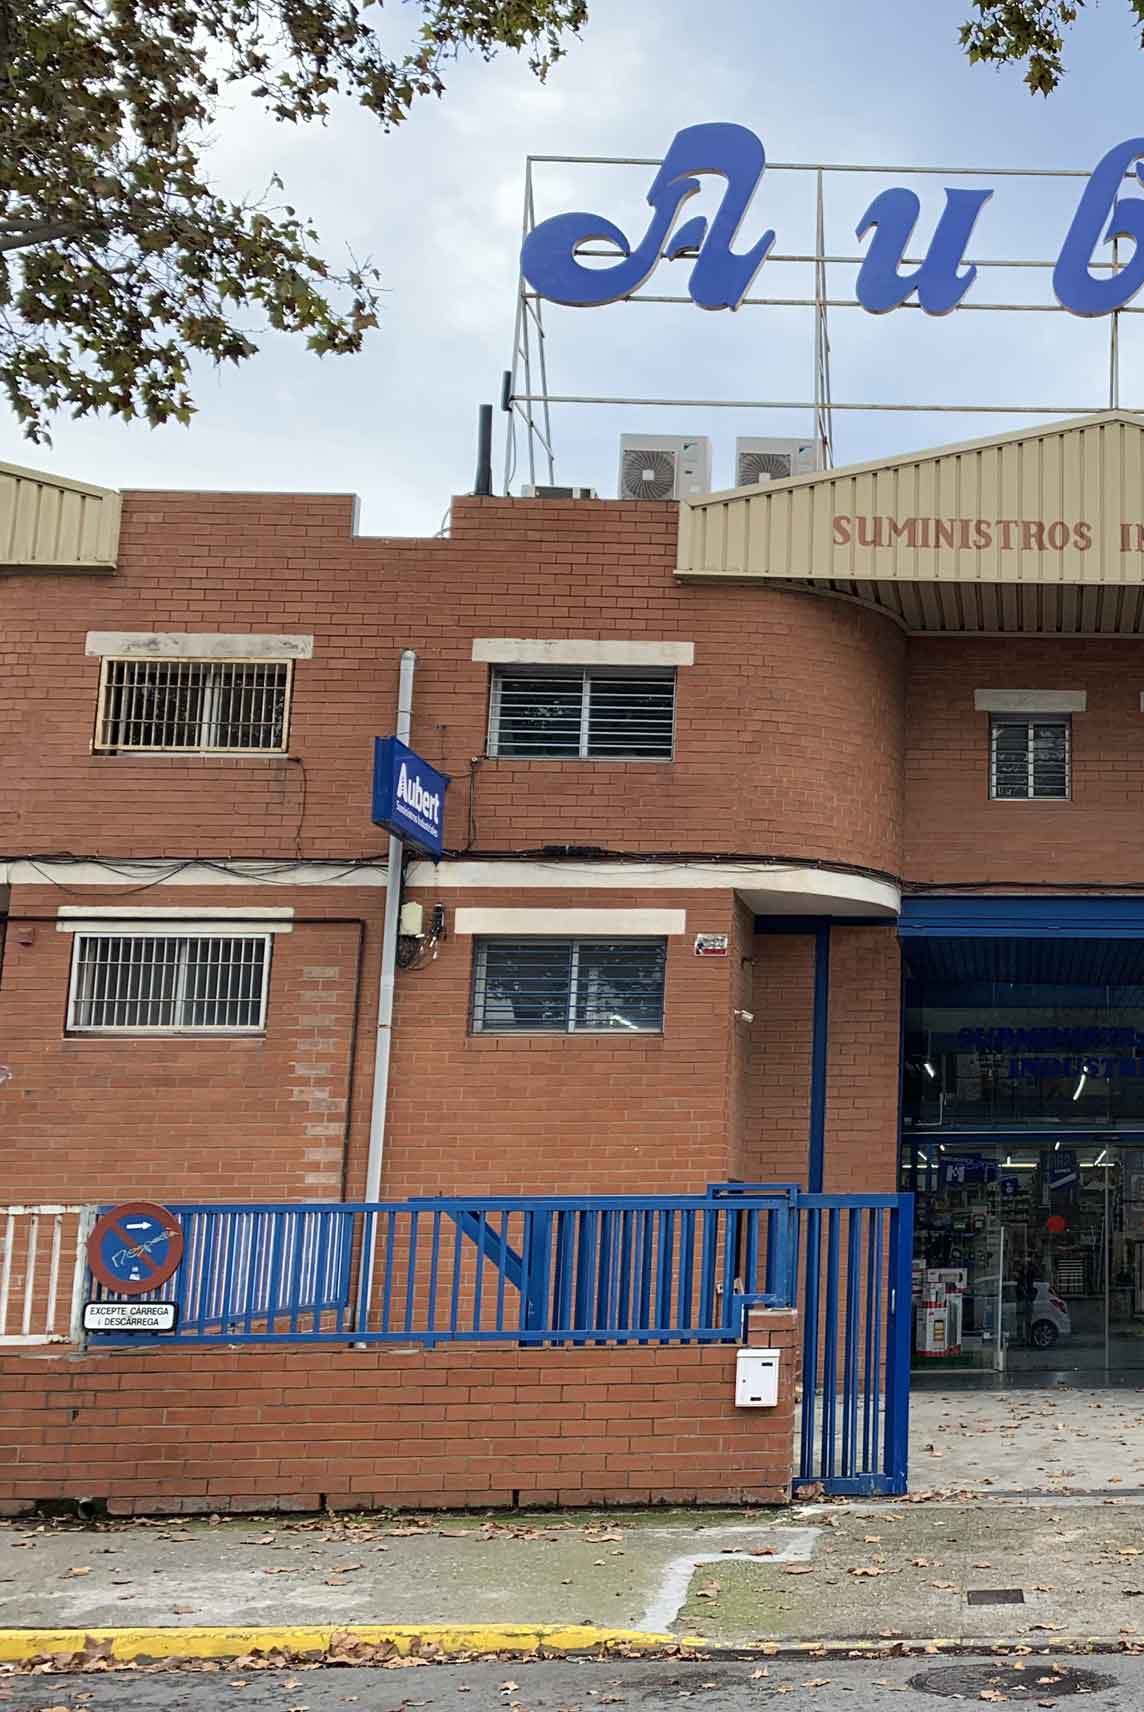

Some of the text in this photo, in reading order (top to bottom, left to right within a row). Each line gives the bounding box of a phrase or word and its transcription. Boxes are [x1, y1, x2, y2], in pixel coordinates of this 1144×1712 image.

[832, 515, 1092, 552] SUMINISTROS
[397, 762, 440, 824] Aubert
[90, 1307, 127, 1315] EXCEPTE
